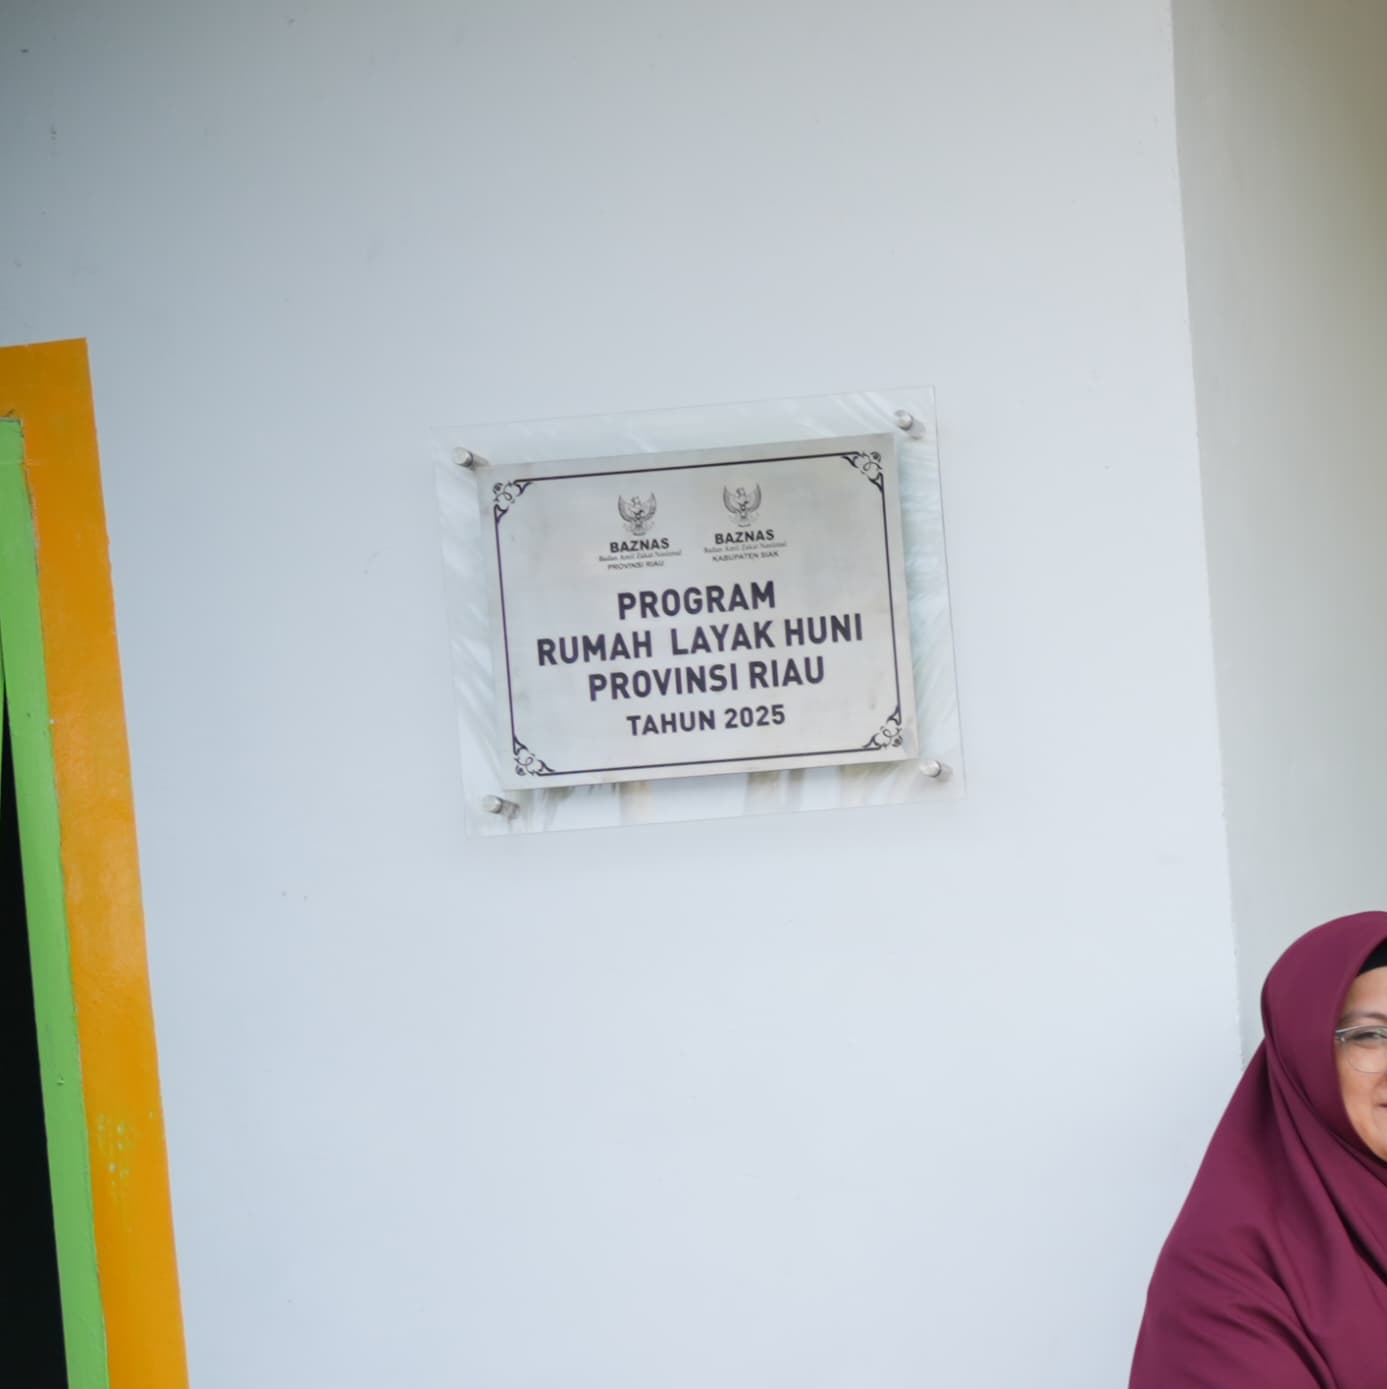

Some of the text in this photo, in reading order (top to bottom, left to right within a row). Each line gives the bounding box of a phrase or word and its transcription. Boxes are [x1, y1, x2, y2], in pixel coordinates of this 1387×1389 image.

[610, 538, 670, 553] BAZNAS
[715, 529, 775, 545] BAZNAS
[608, 561, 644, 570] PROVINSI
[712, 551, 779, 562] KABUPATEN SIAK
[617, 580, 776, 620] PROGRAM
[537, 612, 864, 667] RUMAH LAYAK HUNI
[588, 655, 826, 702] PROVINSI RIAU
[626, 704, 786, 736] TAHUN 2025
